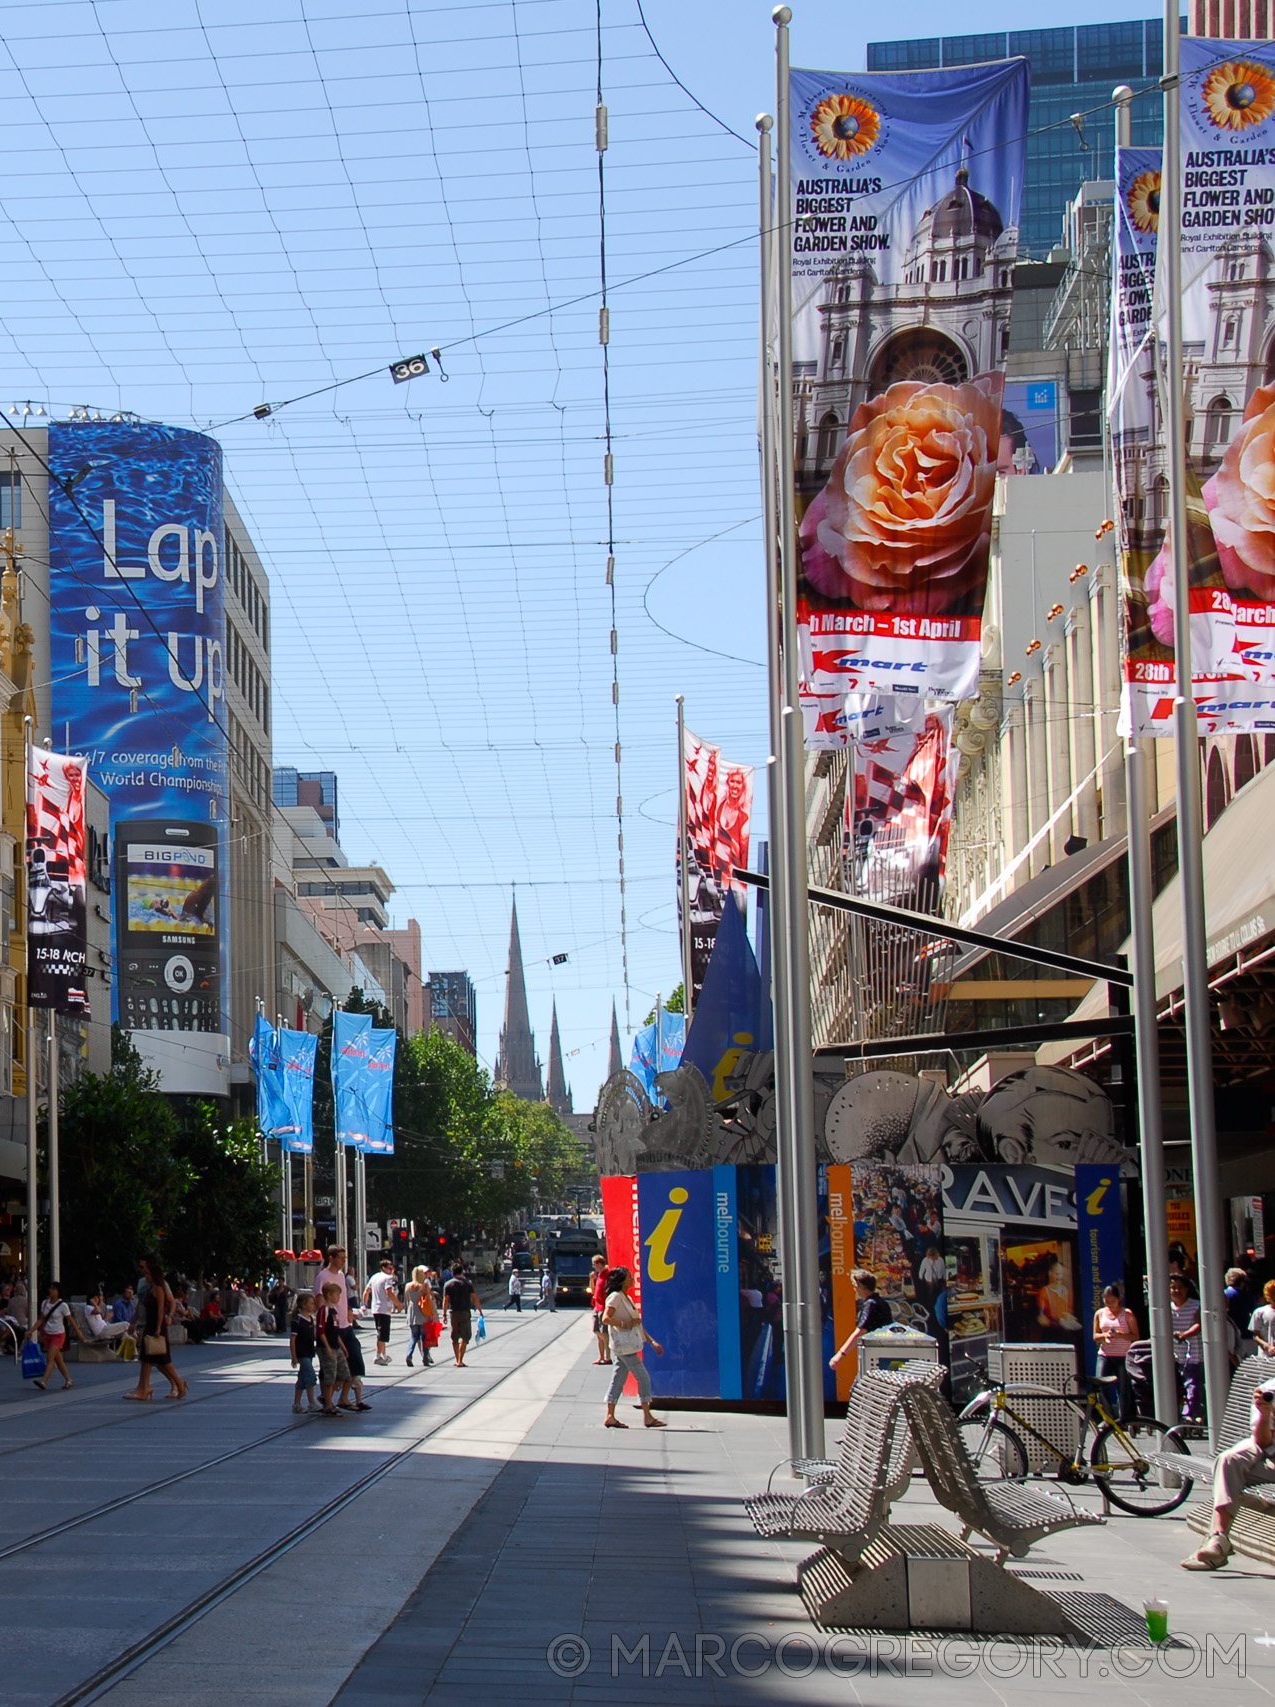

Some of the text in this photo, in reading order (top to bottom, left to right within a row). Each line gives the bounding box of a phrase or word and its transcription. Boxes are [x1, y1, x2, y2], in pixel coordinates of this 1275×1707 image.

[798, 82, 893, 120] Melbourne International
[1189, 103, 1268, 144] Flower & Garden
[799, 132, 816, 162] Flower
[837, 160, 871, 173] Garden
[874, 132, 890, 156] Show
[796, 177, 881, 195] AUSTRALIA'S
[1185, 169, 1247, 188] BIGGEST
[795, 197, 853, 214] BIGGEST
[1183, 188, 1275, 208] FLOWER AND
[794, 216, 877, 233] FLOWER AND
[1181, 208, 1275, 228] GARDEN SHO
[793, 234, 890, 252] GARDEN SHOW.
[1181, 231, 1273, 242] Royal Exhibition Building
[1181, 243, 1260, 253] and Carlton Gardens
[793, 256, 877, 267] Royal Exhibition Building
[792, 268, 805, 276] and
[807, 268, 834, 276] Carlton
[395, 358, 425, 379] 36
[103, 498, 218, 614] Lap
[821, 614, 961, 638] March 1st April
[85, 605, 142, 688] it
[811, 649, 929, 674] Kmart
[1135, 663, 1169, 682] 28th
[815, 704, 885, 734] Kmart
[111, 752, 173, 770] coverage
[207, 758, 217, 772] the
[100, 772, 145, 786] World
[145, 848, 206, 864] BIGPOND
[162, 935, 195, 945] SAMSUNG
[37, 948, 61, 960] 15-18
[83, 966, 93, 976] 37
[175, 970, 184, 978] OK
[643, 1187, 689, 1282] i
[716, 1192, 730, 1273] melbourne
[829, 1192, 845, 1276] melbourne
[1089, 1228, 1101, 1264] tourism
[1091, 1266, 1102, 1284] and
